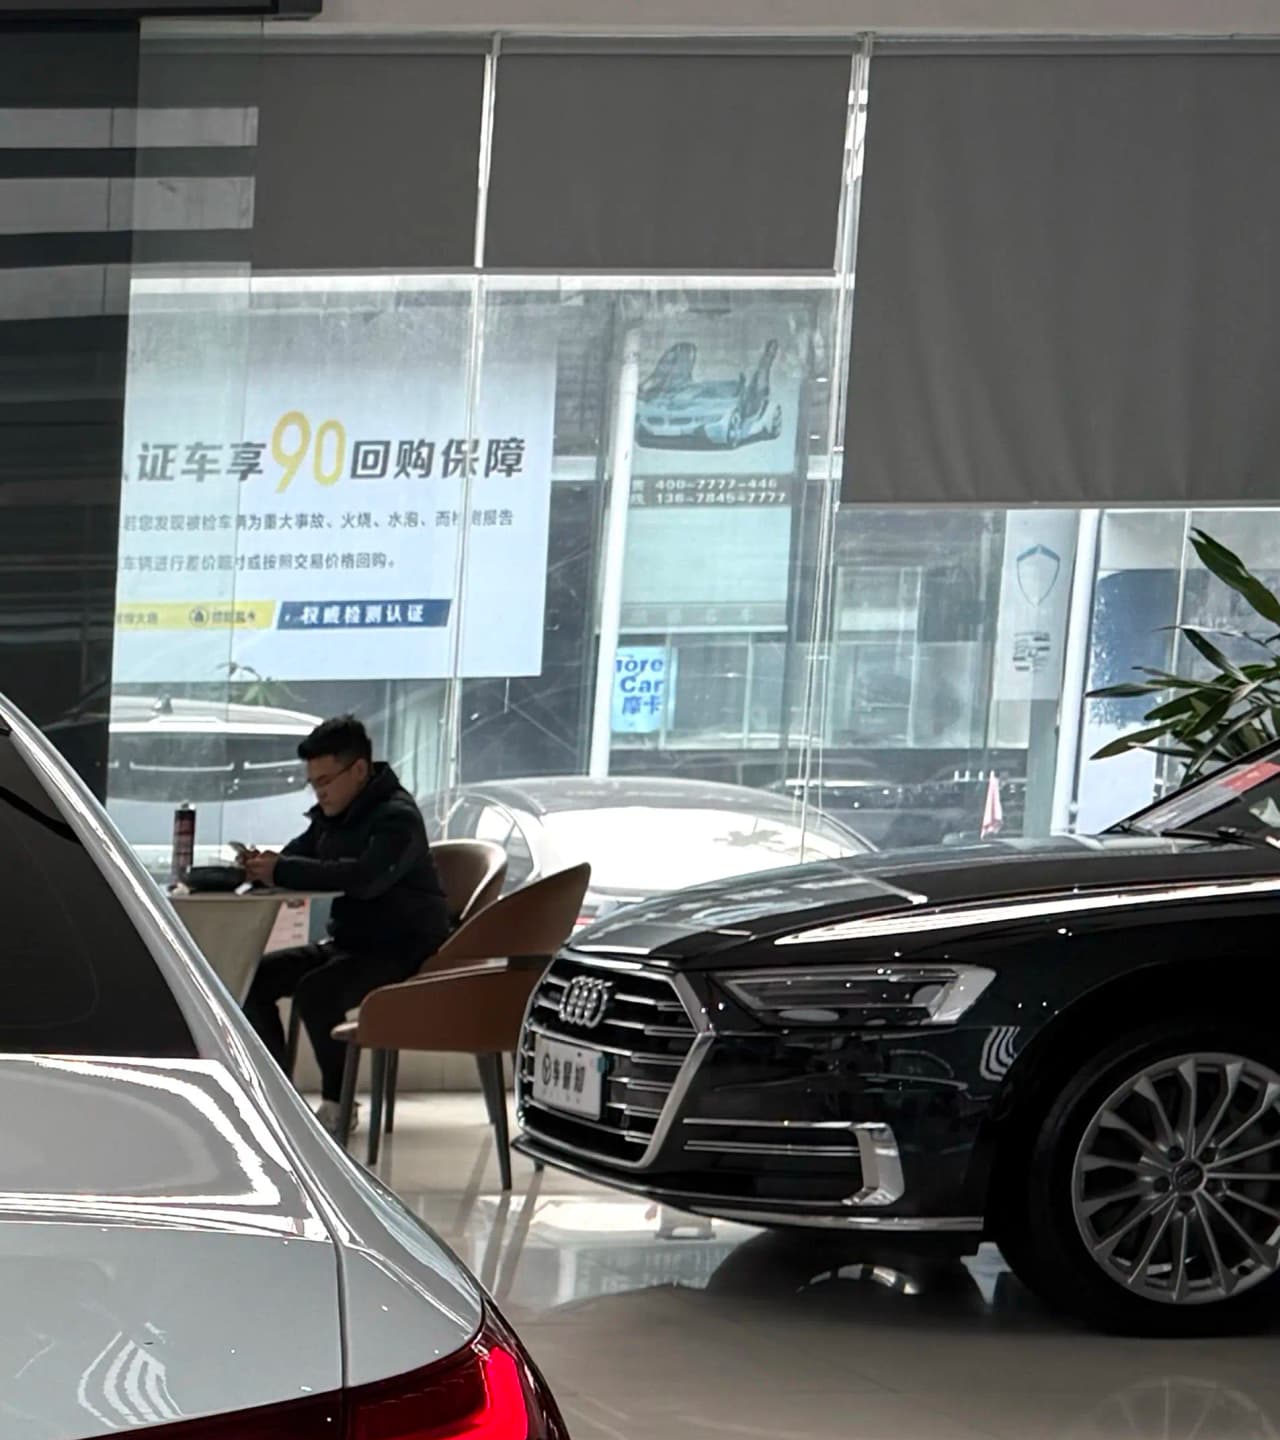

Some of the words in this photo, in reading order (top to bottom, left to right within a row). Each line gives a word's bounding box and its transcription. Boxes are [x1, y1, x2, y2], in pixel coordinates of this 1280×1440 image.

[123, 410, 526, 494] 证车享90回购保障
[301, 604, 425, 625] 权威检测认证
[620, 675, 664, 693] Car
